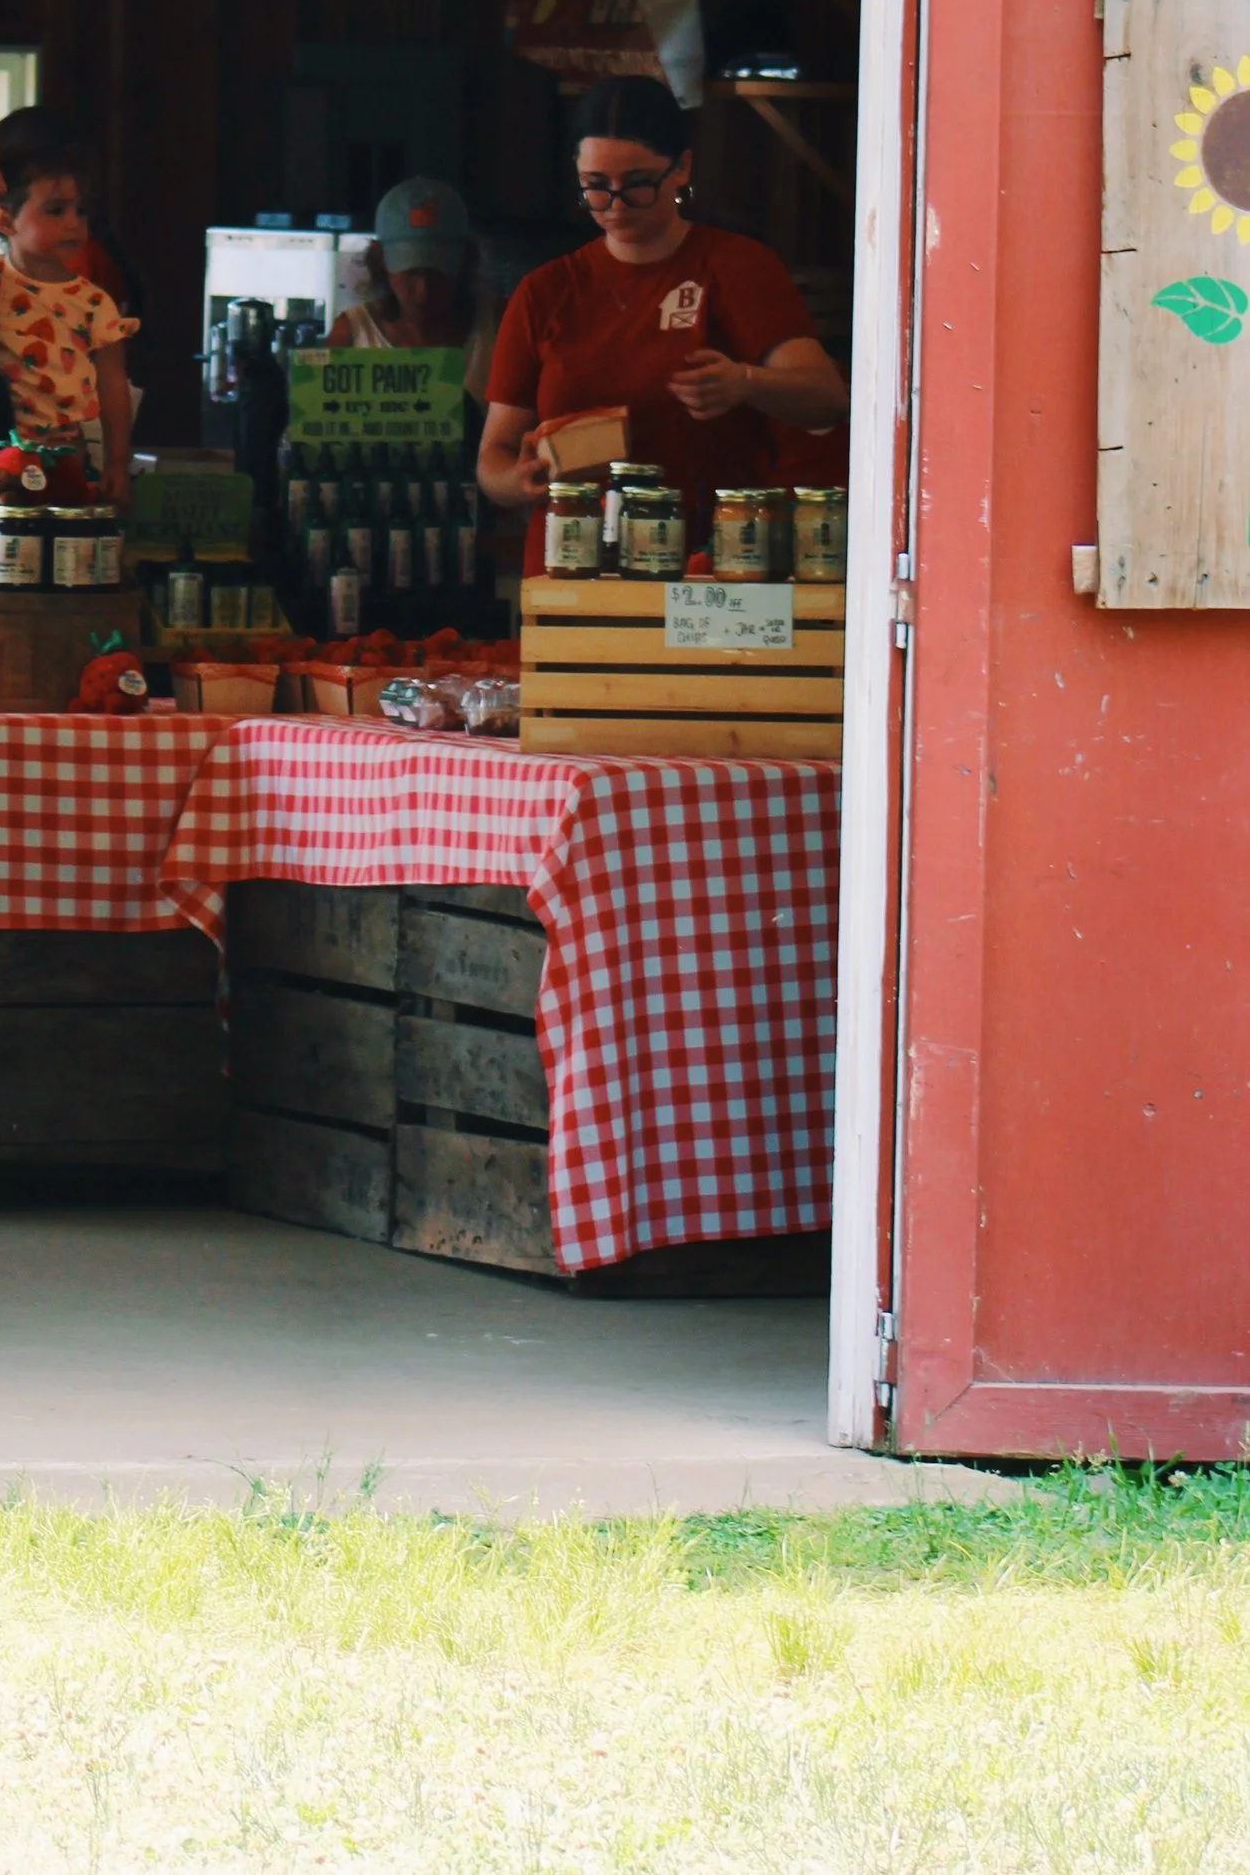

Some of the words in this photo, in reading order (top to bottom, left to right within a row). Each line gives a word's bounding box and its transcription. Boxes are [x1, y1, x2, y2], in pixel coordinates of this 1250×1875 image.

[678, 287, 695, 309] B
[323, 364, 365, 394] GOT
[372, 364, 432, 394] PAIN?
[345, 400, 372, 416] try
[379, 401, 410, 413] me
[673, 616, 694, 630] BAG
[698, 616, 711, 629] OF
[677, 631, 709, 644] CHIPS
